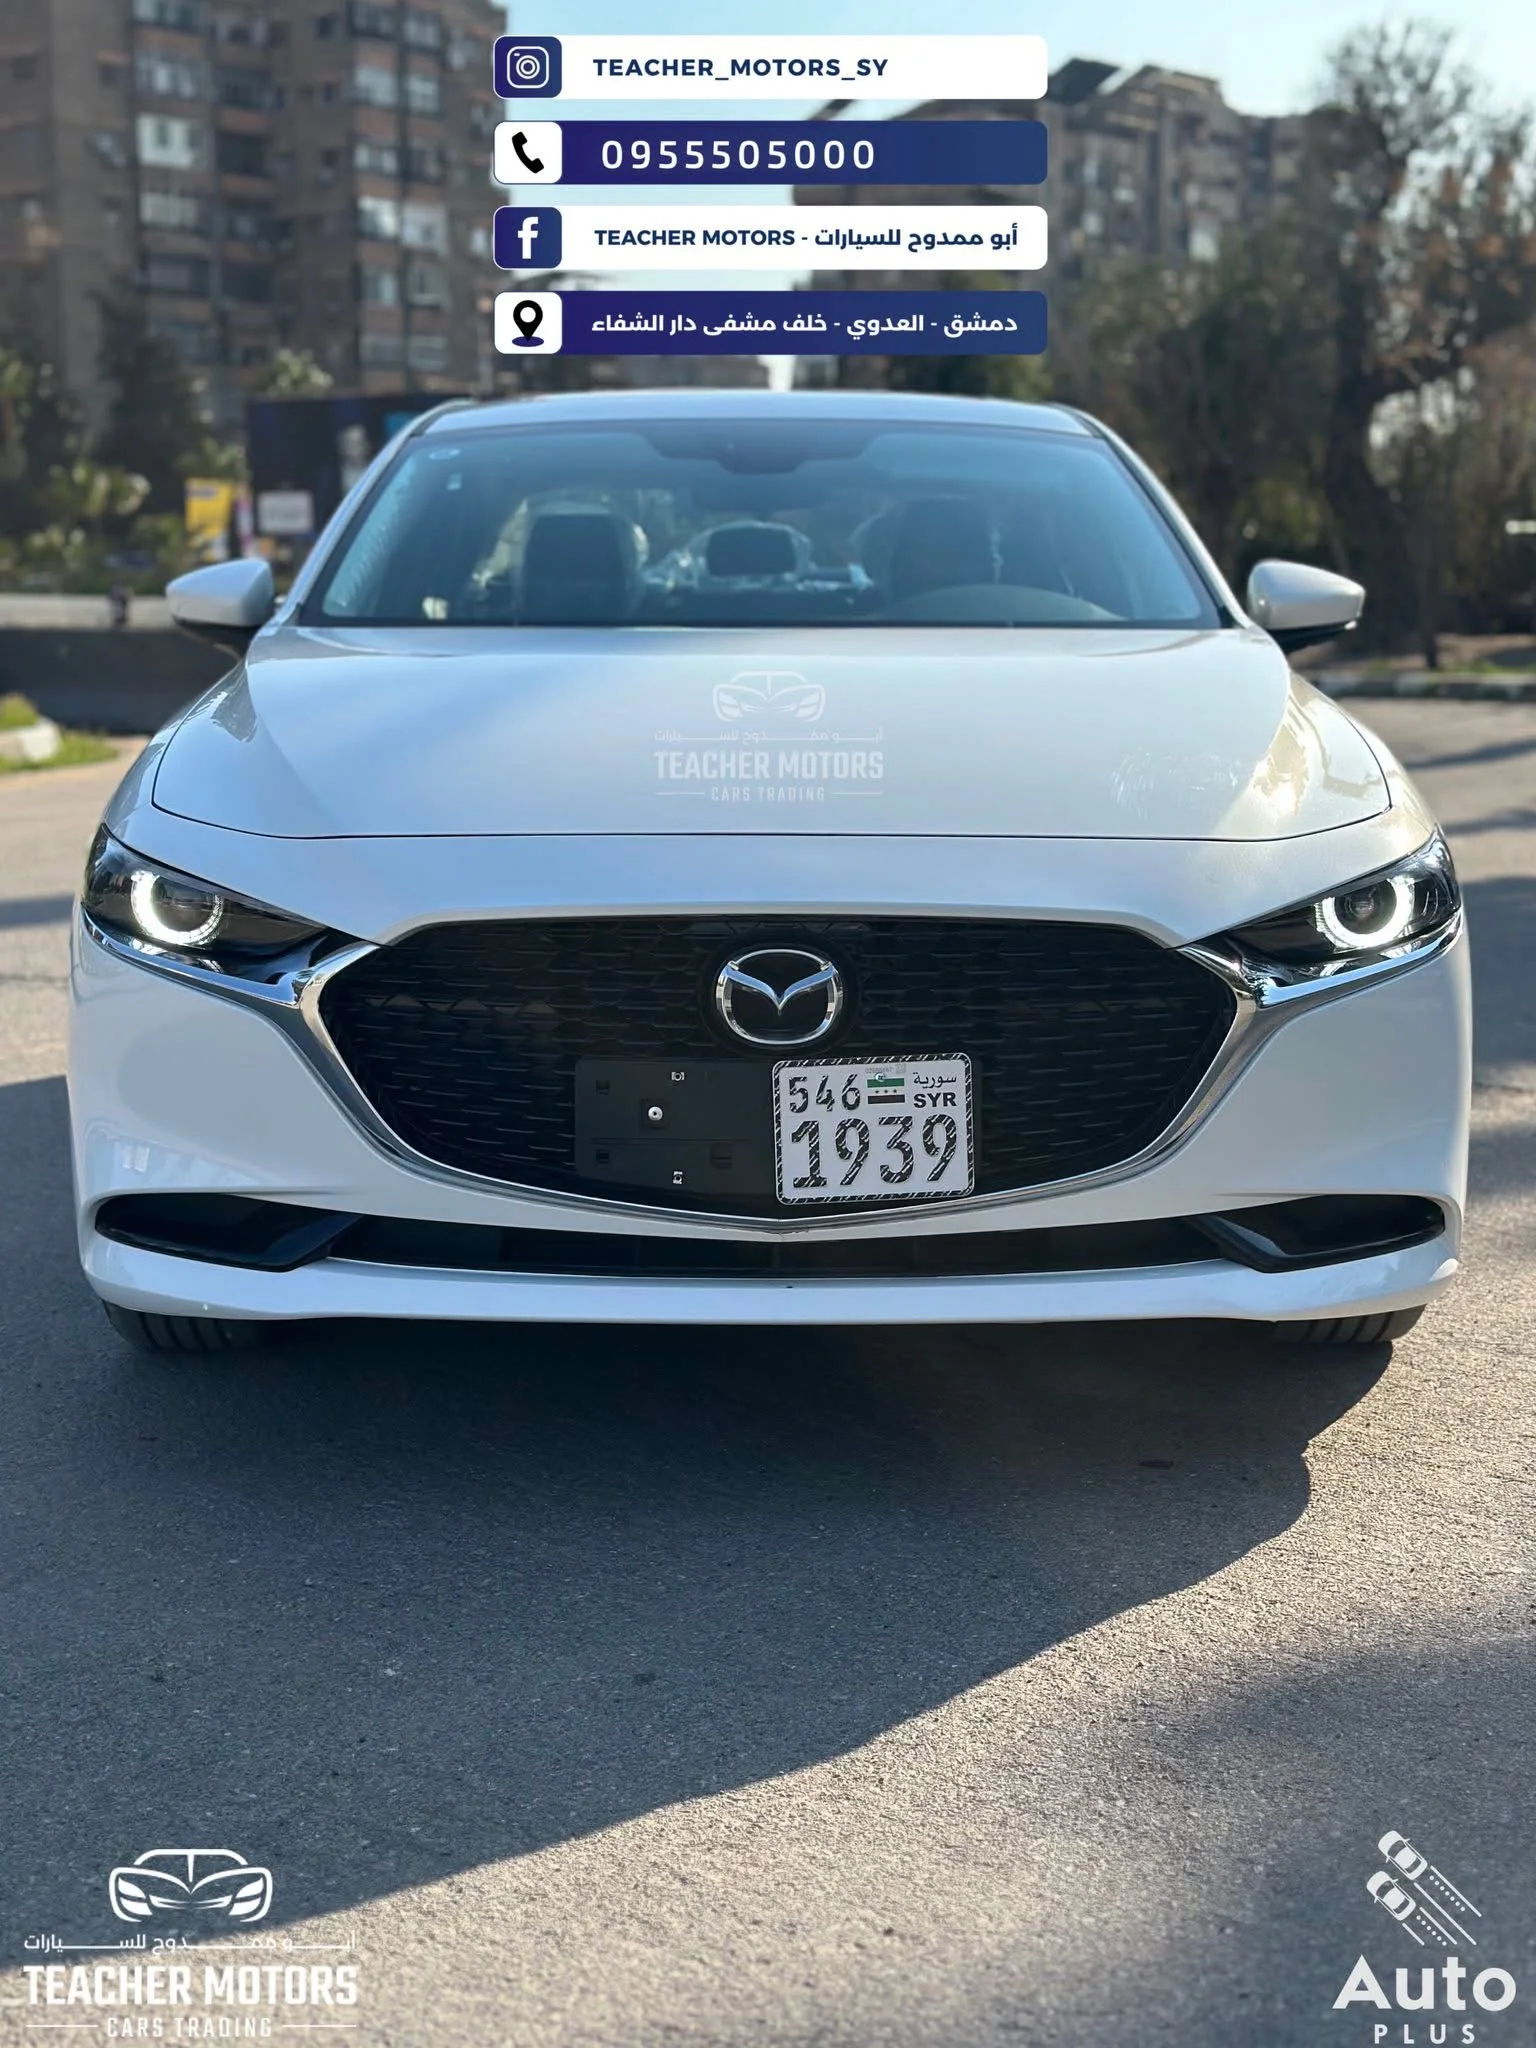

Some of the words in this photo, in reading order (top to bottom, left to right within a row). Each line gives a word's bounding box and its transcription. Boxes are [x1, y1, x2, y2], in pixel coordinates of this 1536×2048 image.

[788, 1073, 861, 1113] 546
[912, 1072, 957, 1089] سورية
[913, 1092, 957, 1109] SYR
[791, 1113, 958, 1188] 1939
